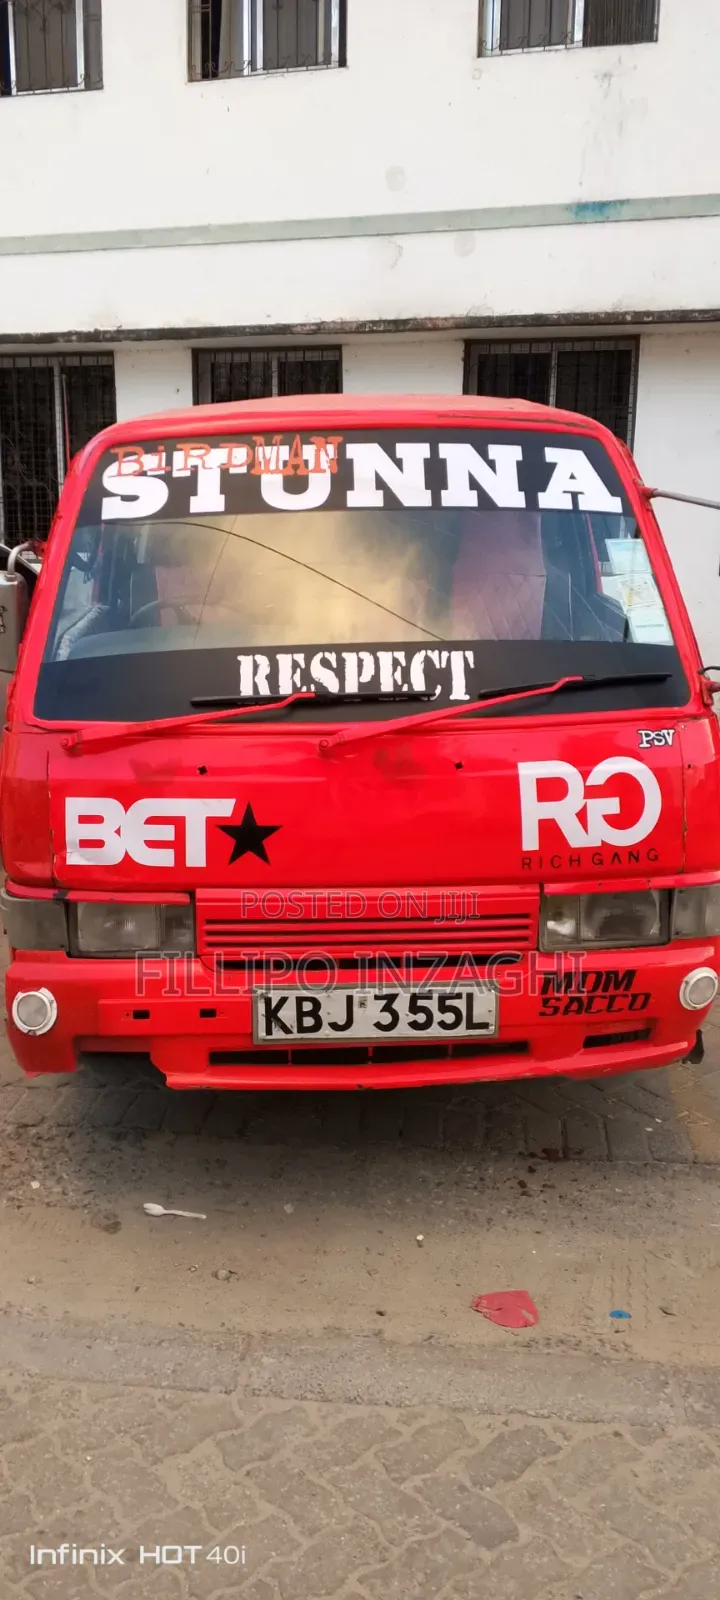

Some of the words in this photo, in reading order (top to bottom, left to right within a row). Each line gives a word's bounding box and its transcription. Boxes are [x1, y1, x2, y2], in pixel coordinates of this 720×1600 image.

[101, 443, 622, 520] STUNNA
[237, 650, 475, 700] RESPECT
[638, 729, 675, 748] PSV
[65, 797, 236, 867] BET
[521, 855, 581, 870] RICH
[591, 848, 659, 866] GANG
[264, 994, 354, 1036] KBJ
[373, 992, 490, 1032] 355L
[538, 993, 652, 1017] SACCO
